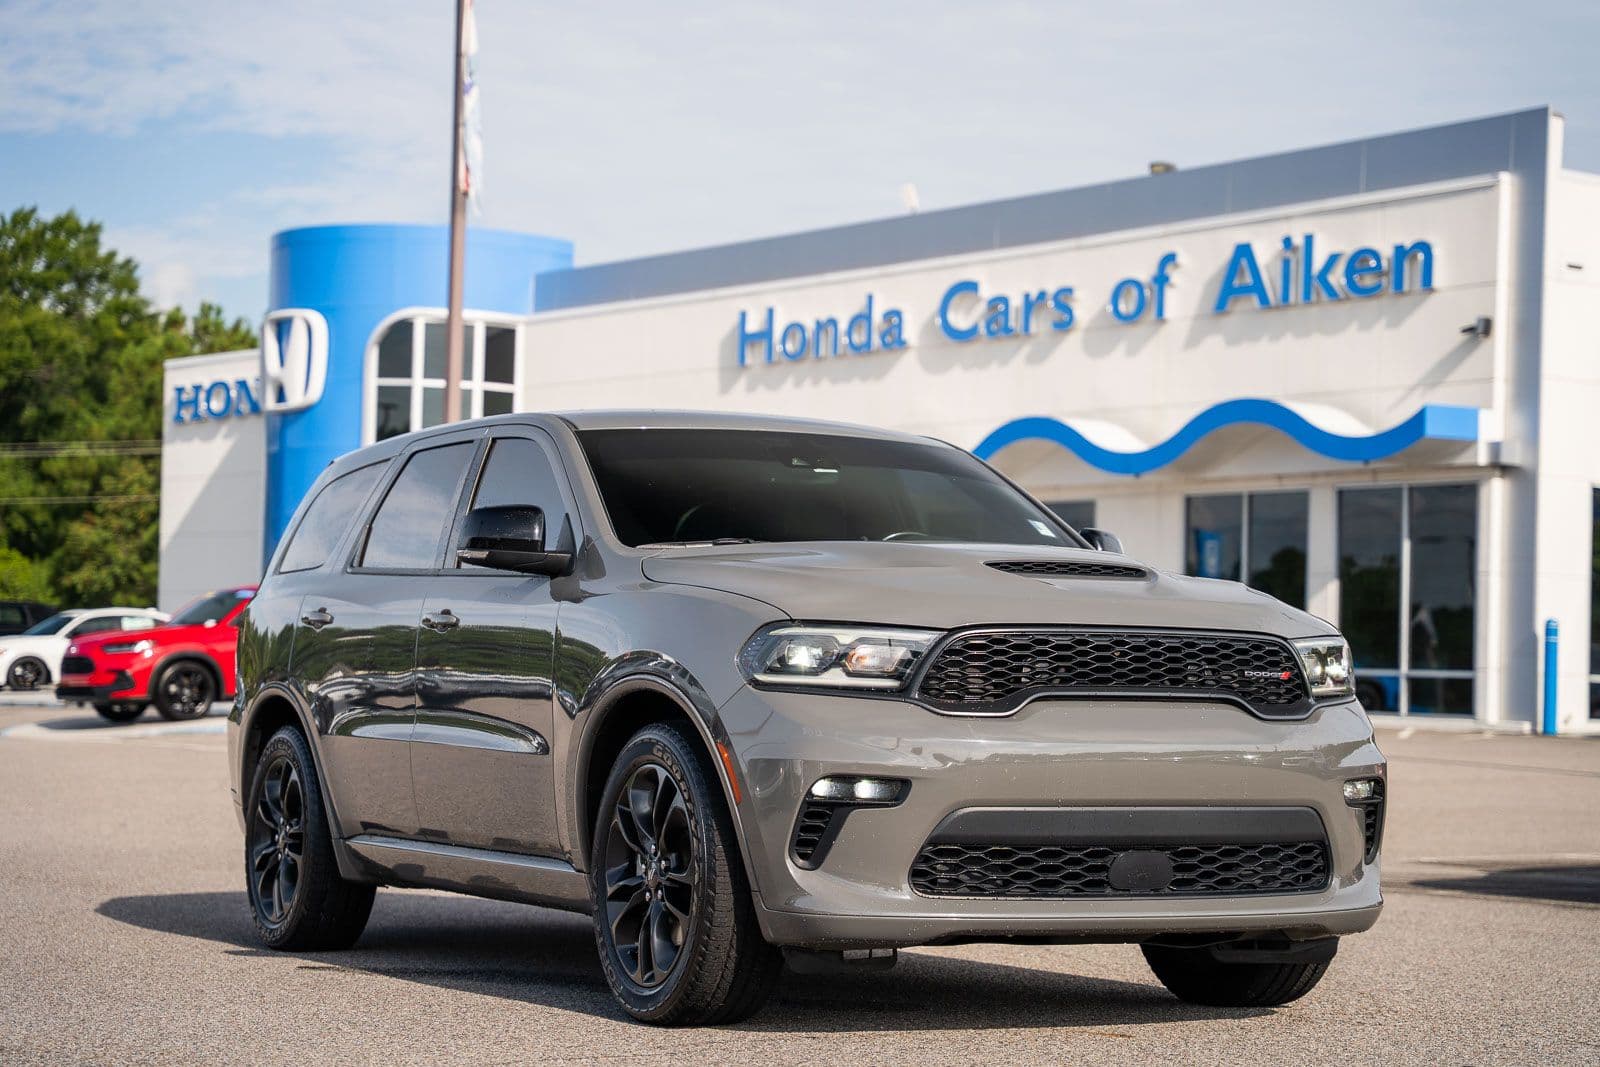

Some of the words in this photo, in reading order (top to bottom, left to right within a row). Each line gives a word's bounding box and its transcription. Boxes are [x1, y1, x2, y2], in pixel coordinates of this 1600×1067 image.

[737, 293, 906, 367] Honda
[938, 280, 1075, 341] Cars
[1111, 253, 1177, 323] of
[1214, 233, 1434, 313] Aiken
[173, 379, 262, 424] HON
